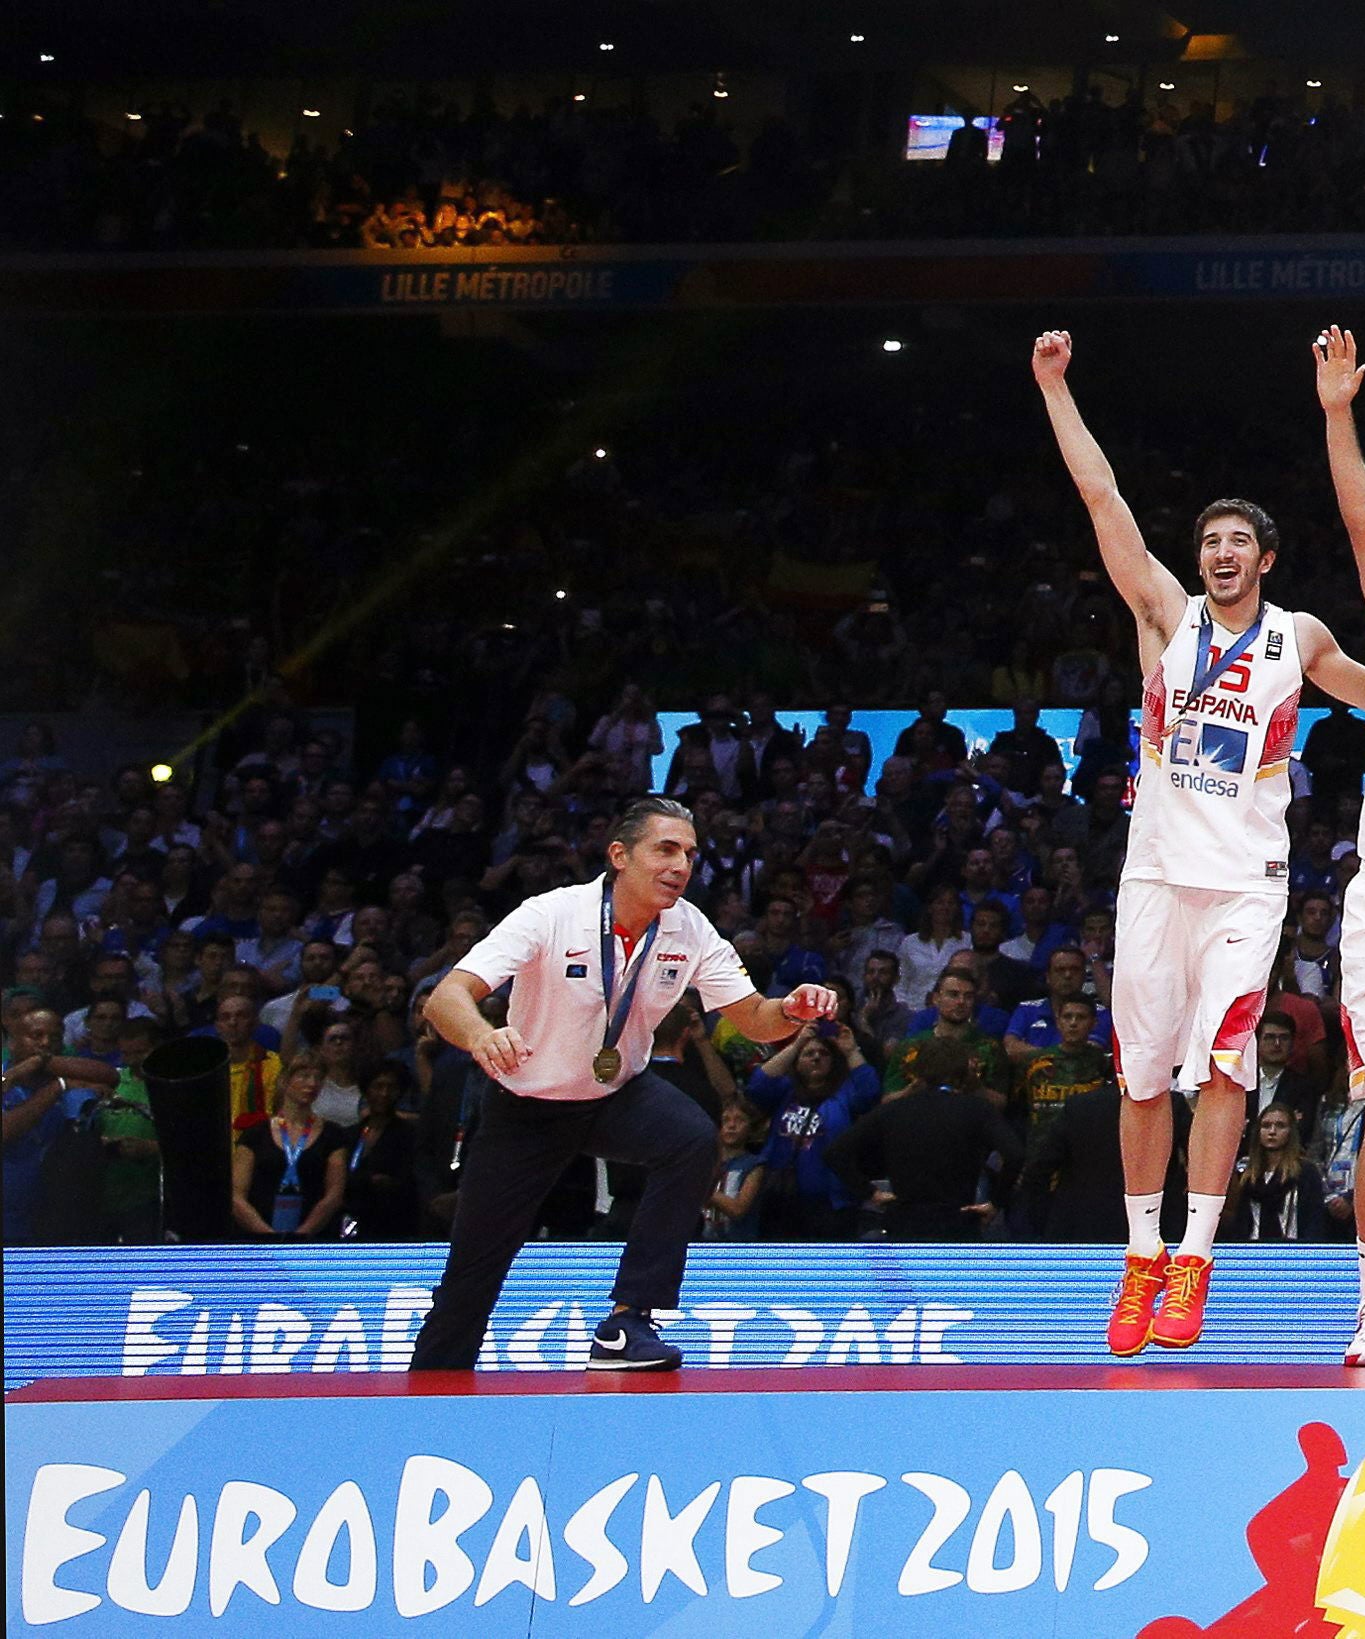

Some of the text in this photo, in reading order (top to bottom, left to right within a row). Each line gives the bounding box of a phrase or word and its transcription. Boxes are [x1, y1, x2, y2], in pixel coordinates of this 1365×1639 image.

[381, 266, 615, 300] LILLE MÉTROPOLE
[1196, 259, 1265, 290] LILLE
[1170, 771, 1239, 798] endesa
[21, 1454, 1153, 1625] EUROBASKET 2015
